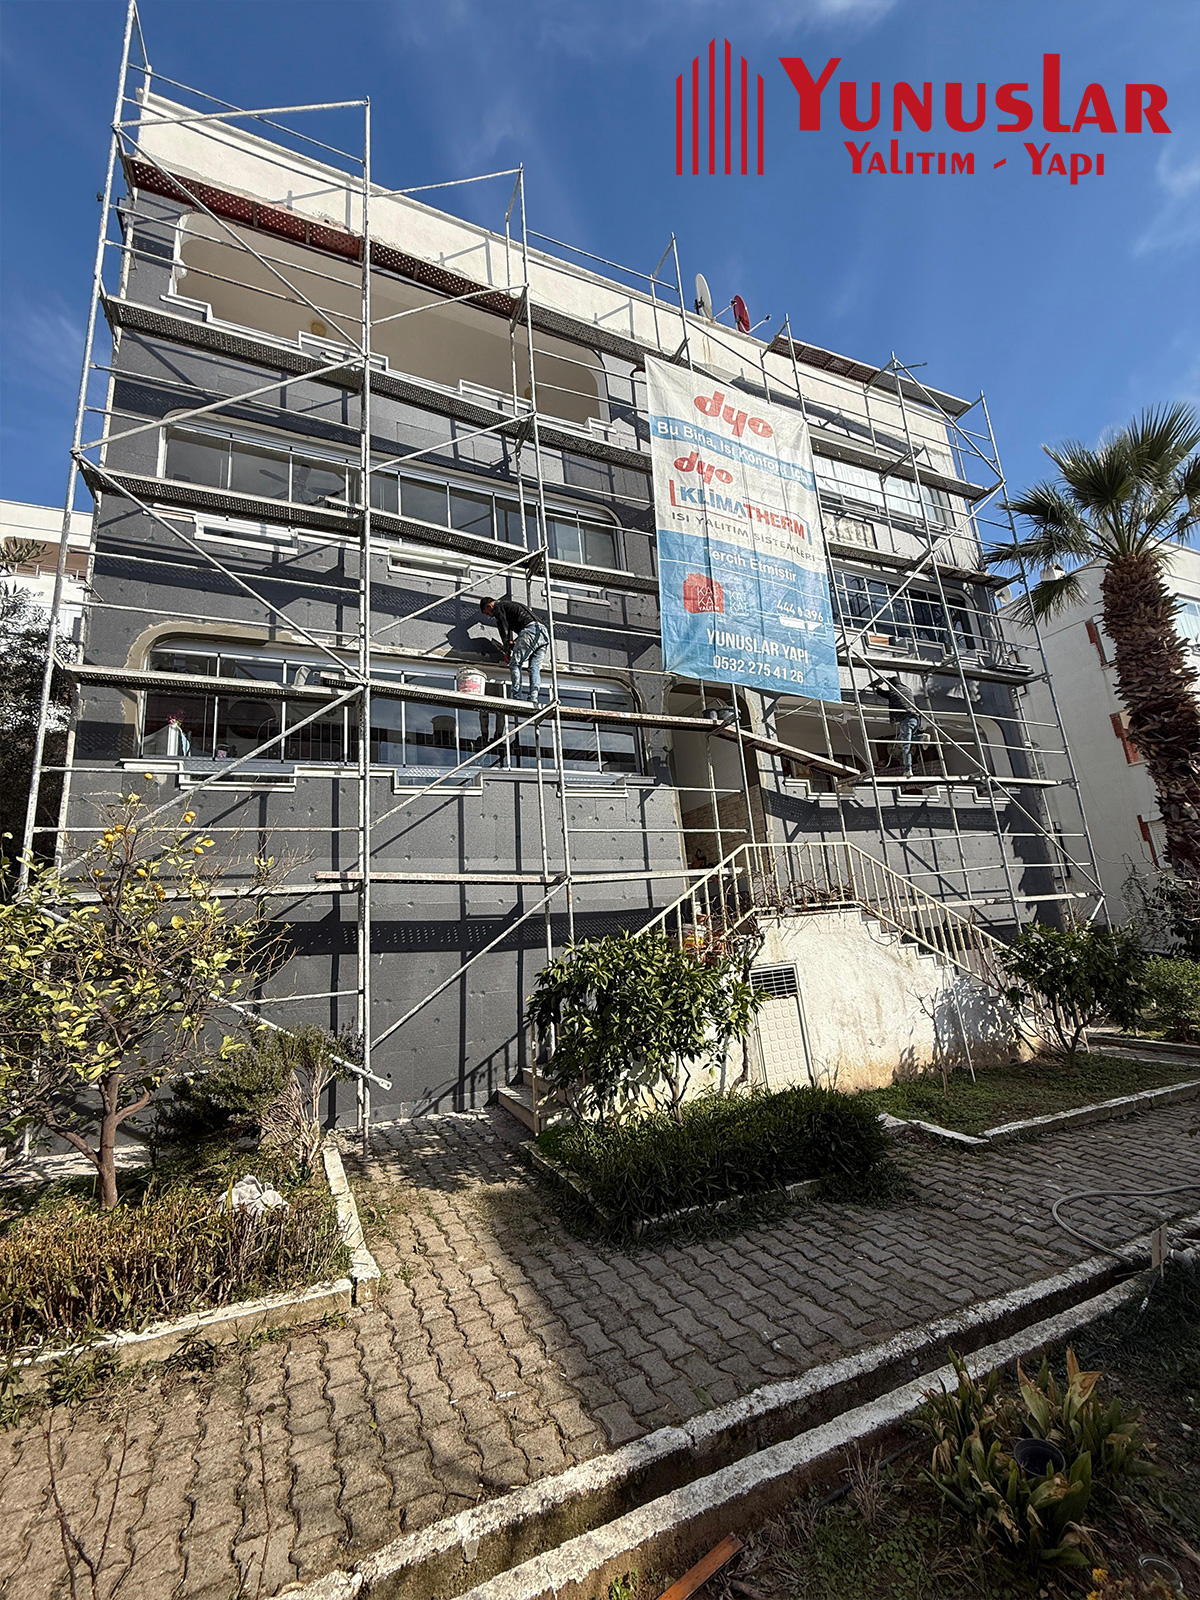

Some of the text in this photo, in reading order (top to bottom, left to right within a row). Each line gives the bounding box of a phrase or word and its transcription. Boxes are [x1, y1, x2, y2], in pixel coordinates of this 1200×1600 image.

[657, 421, 679, 436] Bu
[693, 390, 774, 438] dyo
[673, 451, 733, 485] dyo
[672, 512, 689, 523] ISI
[695, 516, 749, 539] YALITIM
[750, 552, 797, 582] Etmiştir
[777, 599, 796, 615] 444
[804, 608, 824, 622] 396
[706, 628, 809, 664] YUNUSLAR YAPI
[713, 654, 804, 684] 0532 275 41 26
